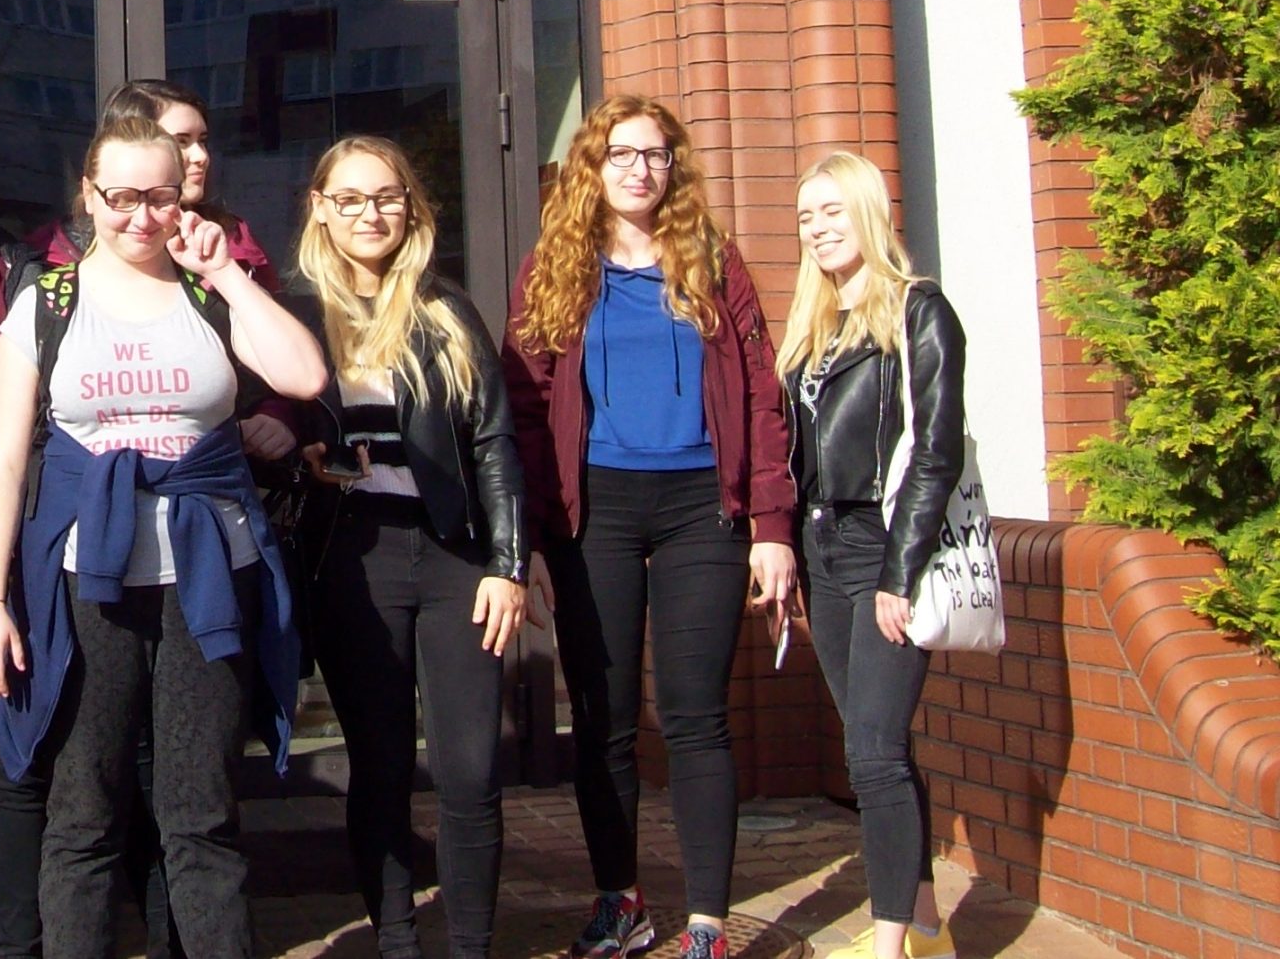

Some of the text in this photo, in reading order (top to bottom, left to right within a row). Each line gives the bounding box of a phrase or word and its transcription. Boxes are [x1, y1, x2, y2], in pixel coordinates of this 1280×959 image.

[113, 342, 154, 362] WE
[80, 367, 191, 401] SHOULD
[95, 404, 182, 427] ALL BE
[950, 589, 963, 611] is
